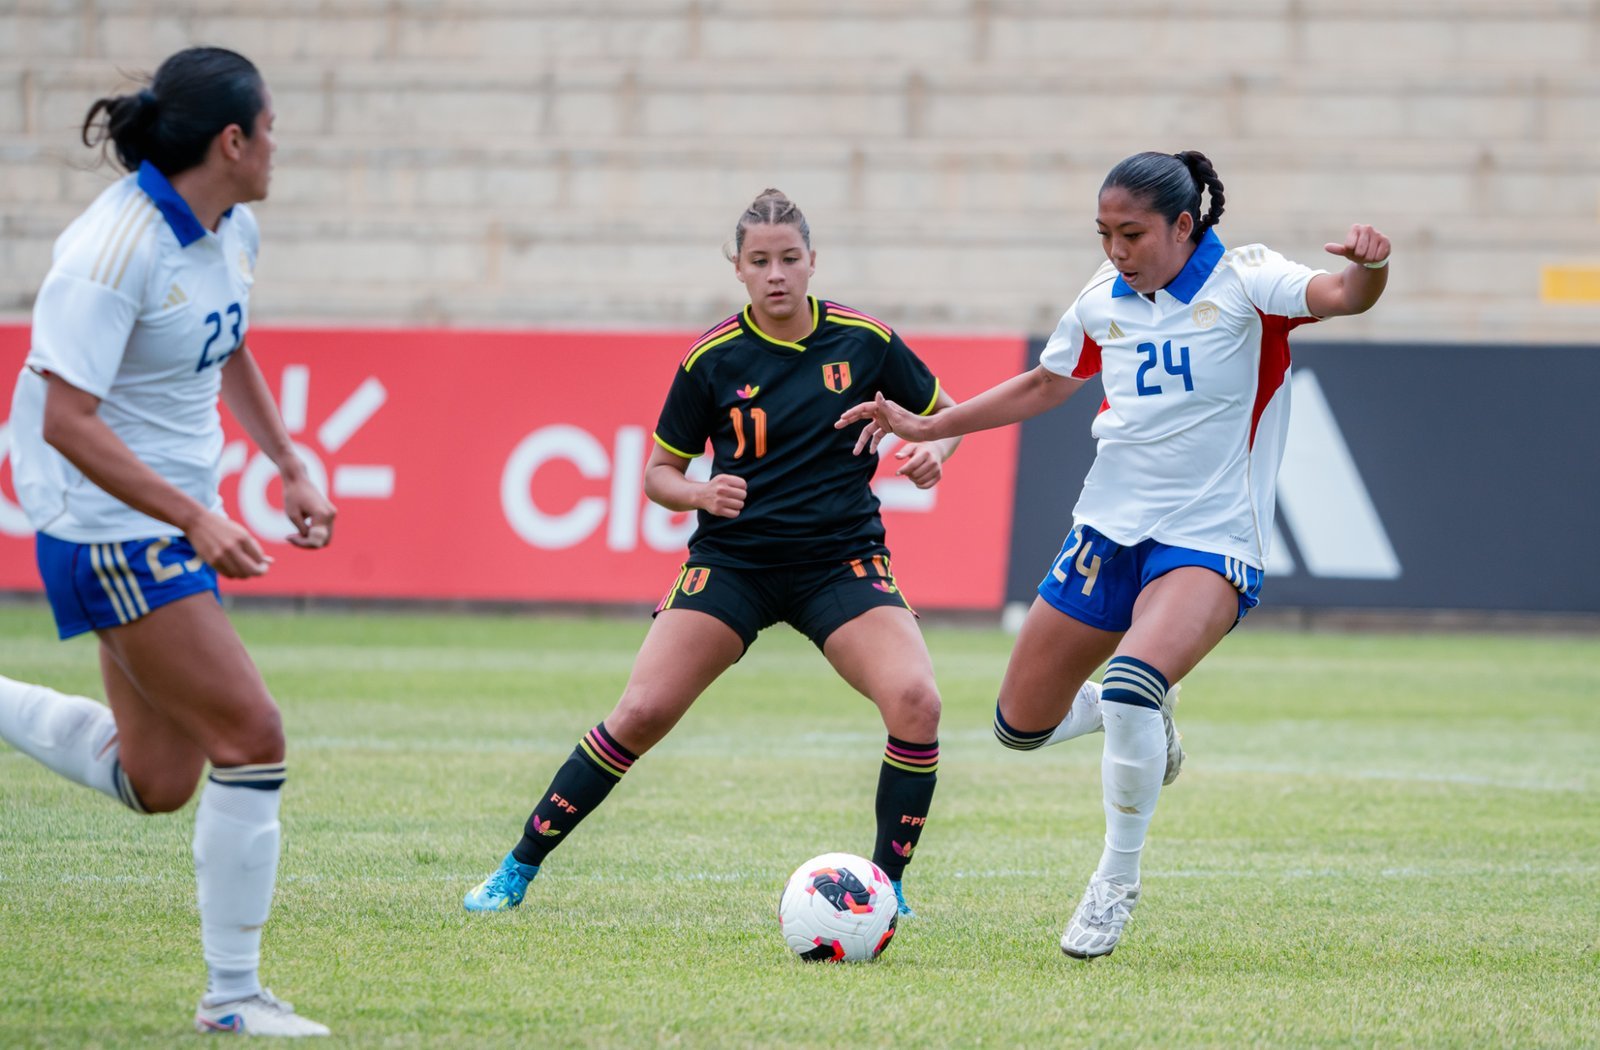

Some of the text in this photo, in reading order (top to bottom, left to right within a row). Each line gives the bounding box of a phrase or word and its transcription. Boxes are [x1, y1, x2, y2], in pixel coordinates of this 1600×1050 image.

[196, 302, 244, 372] 23
[1136, 340, 1194, 396] 24
[730, 407, 767, 459] 11
[1052, 527, 1101, 597] 24
[551, 793, 578, 814] FPF
